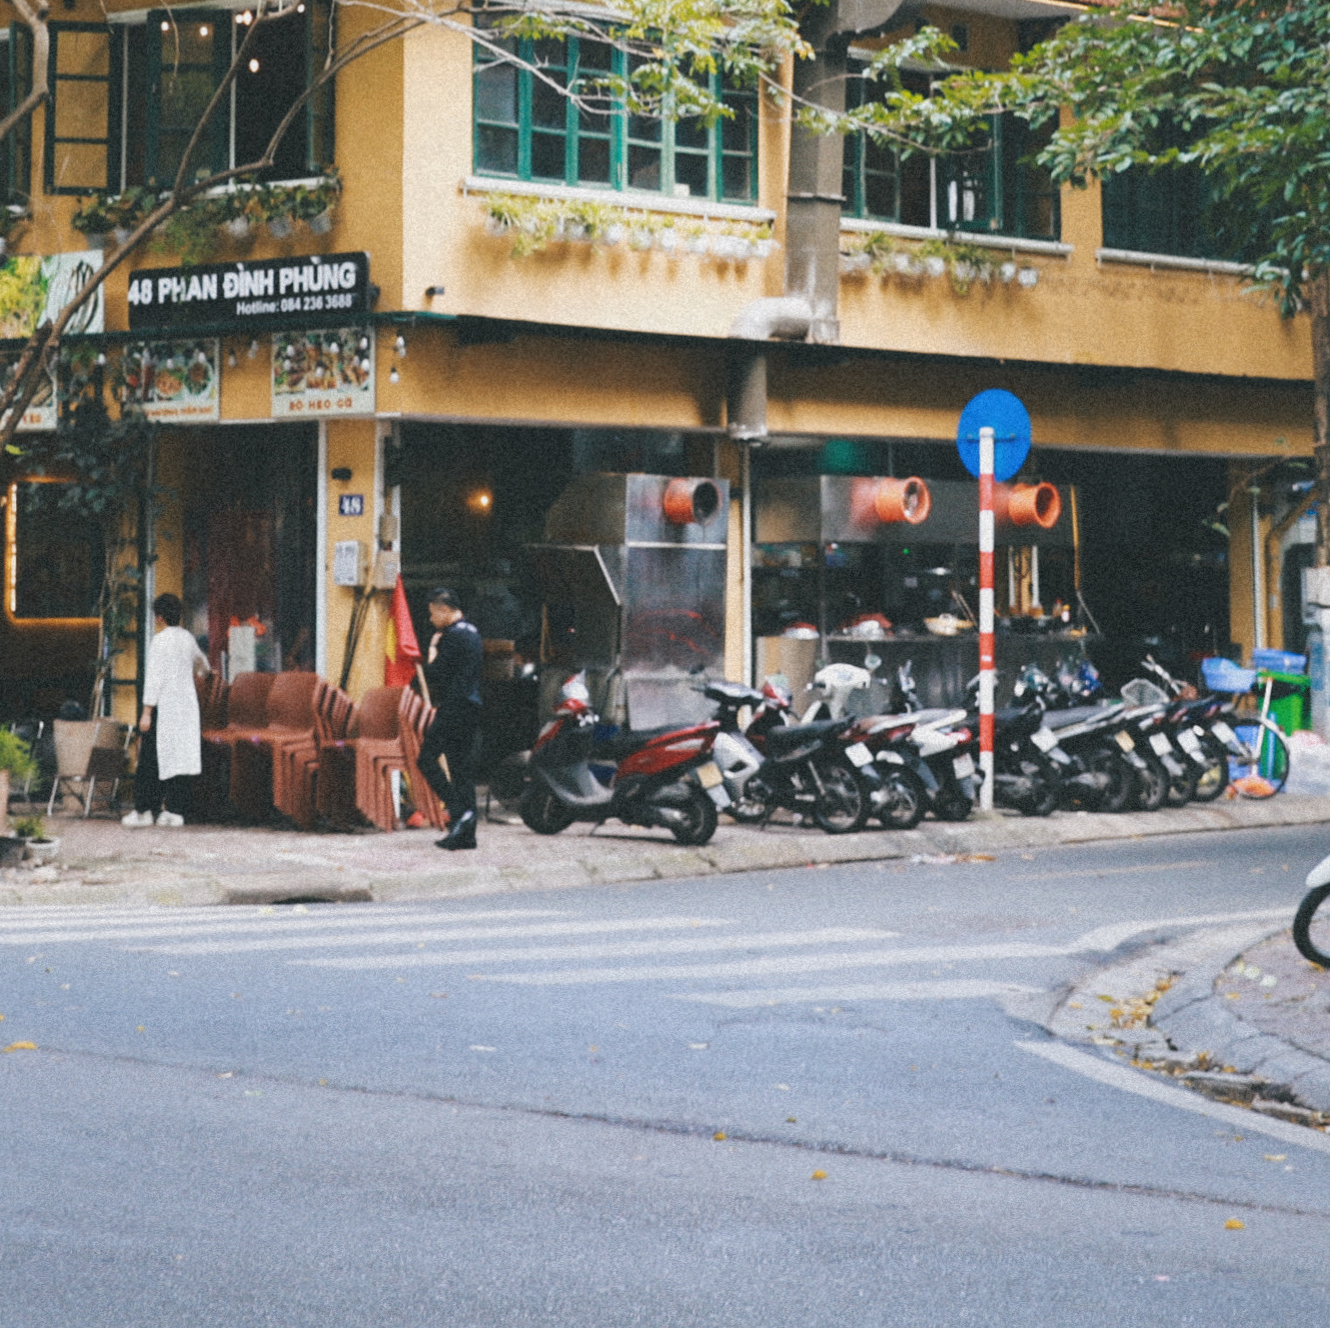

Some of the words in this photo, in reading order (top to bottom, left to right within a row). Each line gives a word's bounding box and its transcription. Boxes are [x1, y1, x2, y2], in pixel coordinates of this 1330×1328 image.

[127, 278, 153, 306] 48
[158, 273, 218, 305] PHAN
[222, 262, 275, 299] ĐÌNH
[279, 256, 357, 295] PHÙNG
[236, 299, 280, 316] Hotline:
